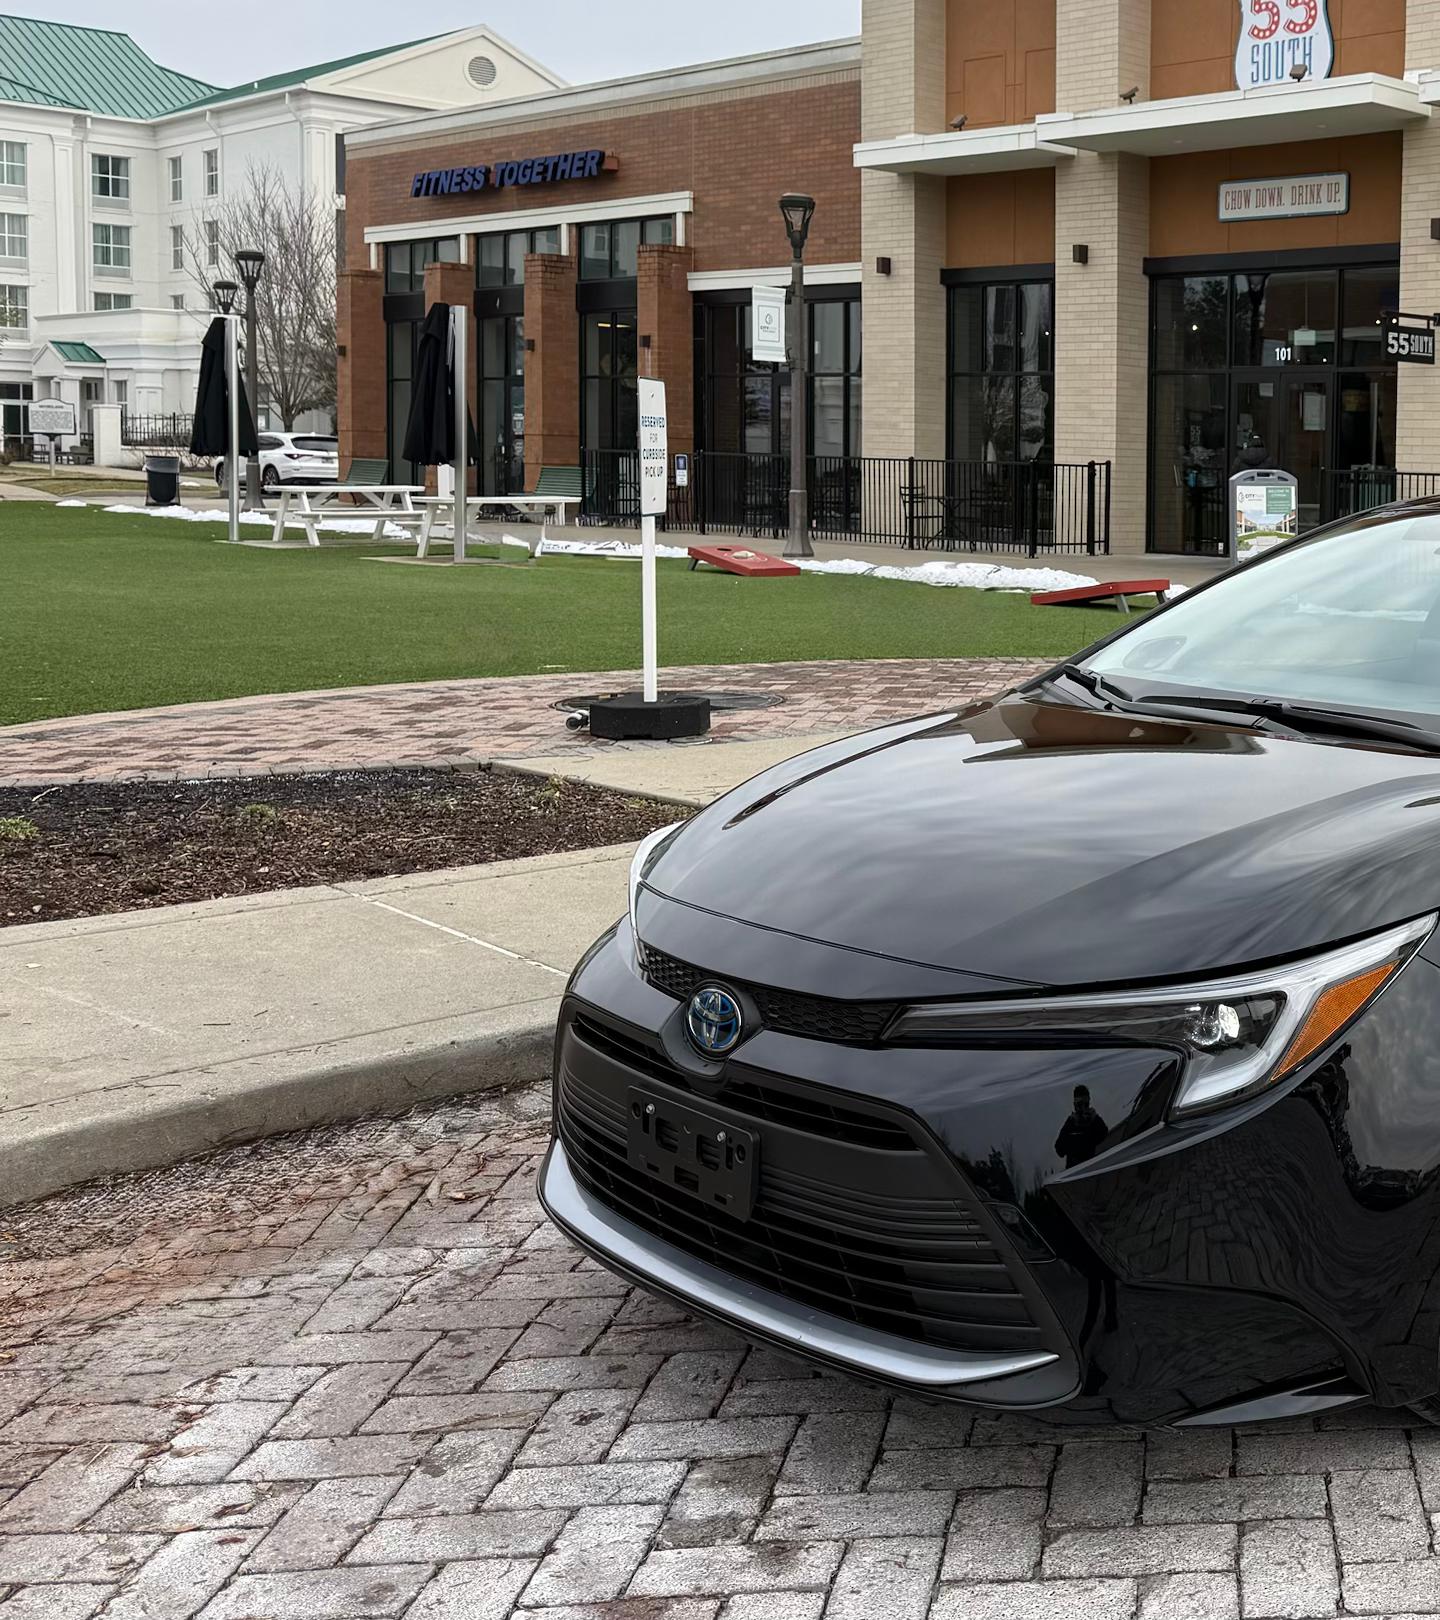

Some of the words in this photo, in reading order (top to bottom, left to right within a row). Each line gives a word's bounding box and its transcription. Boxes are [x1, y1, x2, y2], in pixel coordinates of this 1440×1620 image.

[1248, 0, 1317, 39] 55
[1251, 35, 1314, 83] SOUTH
[410, 164, 491, 198] FITNESS
[494, 149, 605, 188] TOGETHER
[1224, 188, 1252, 211] CHOW
[1255, 186, 1285, 209] DOWN.
[1291, 183, 1322, 206] DRINK
[1387, 331, 1409, 355] 55
[1410, 334, 1433, 353] SOUTH
[1274, 347, 1292, 361] 101
[641, 415, 665, 428] RESERVED
[649, 433, 658, 443] FOR
[643, 448, 666, 460] CURBSIDE
[645, 466, 656, 478] PICK
[657, 466, 664, 477] UP
